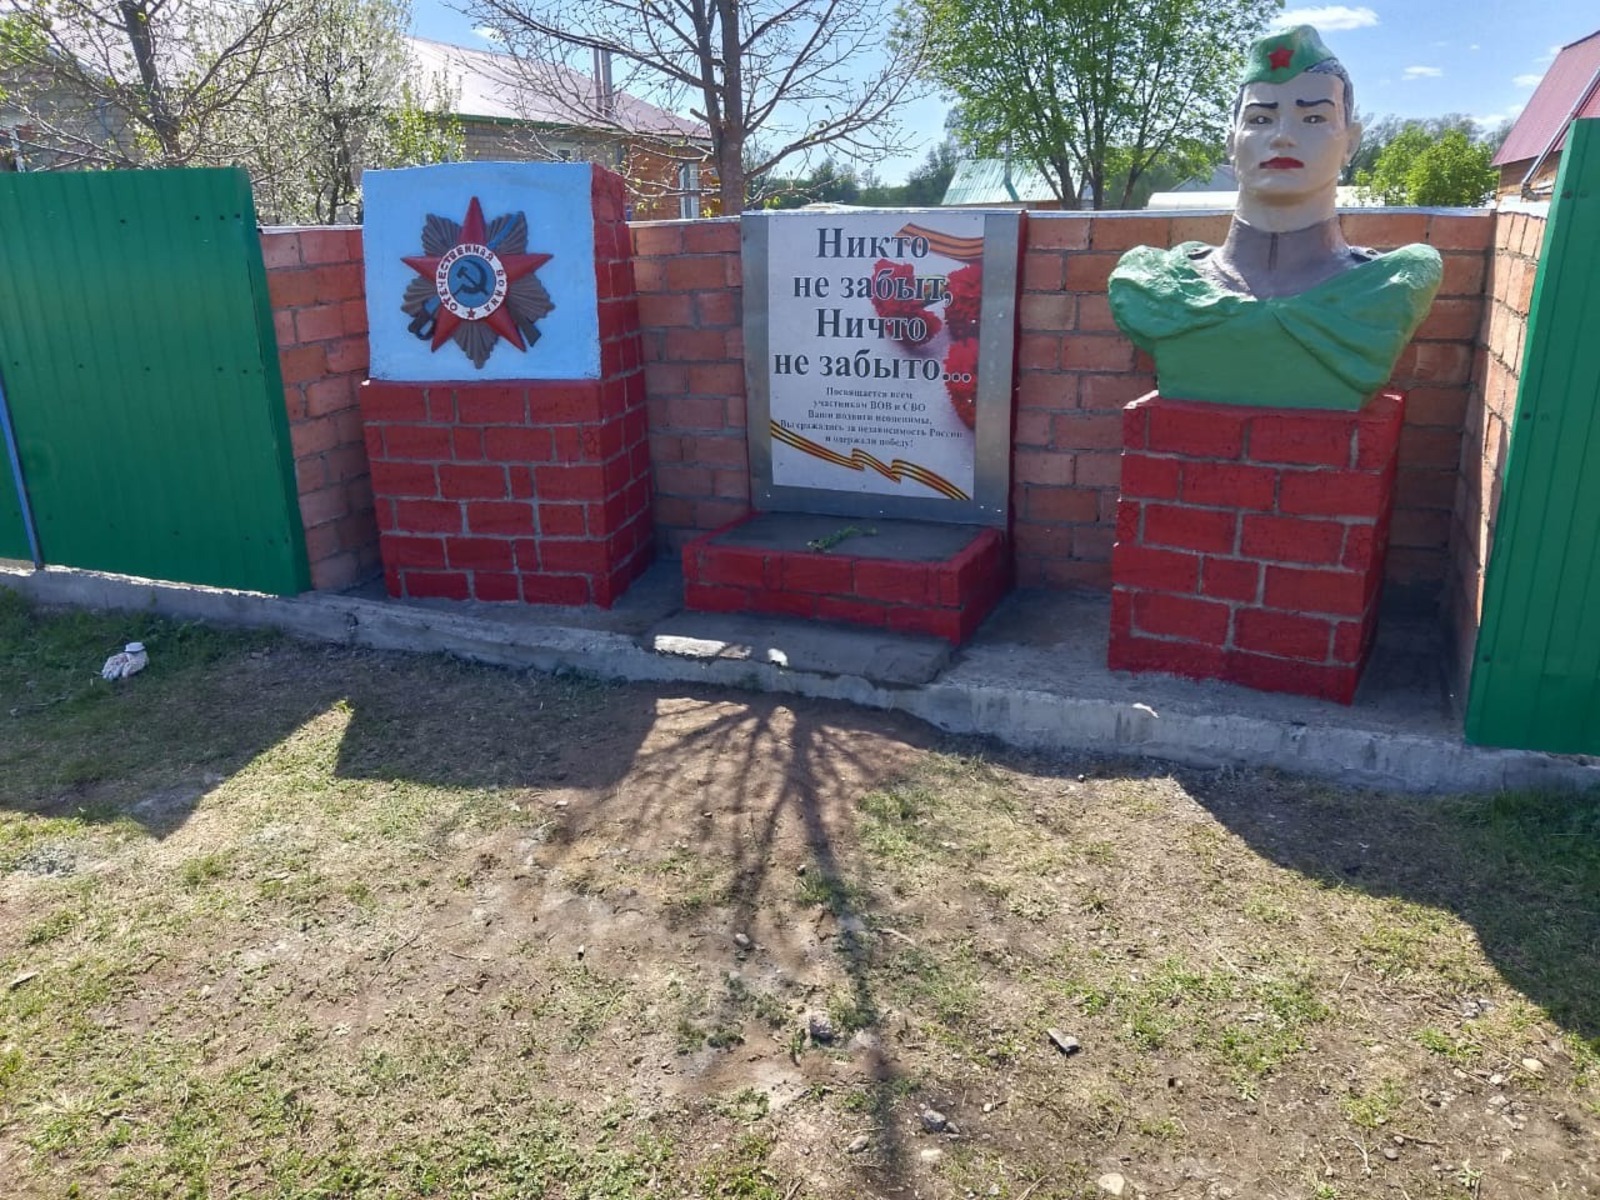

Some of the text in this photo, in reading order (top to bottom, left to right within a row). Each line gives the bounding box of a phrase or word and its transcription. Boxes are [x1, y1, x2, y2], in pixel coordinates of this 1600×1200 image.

[816, 228, 931, 259] Никто
[794, 268, 953, 305] не забыт,
[816, 308, 927, 340] Ничто
[774, 349, 972, 383] не забыто...
[813, 400, 868, 409] участникам
[870, 401, 892, 410] ВОВ
[903, 402, 926, 412] СВО
[826, 387, 913, 400] Посвящается всем
[808, 409, 834, 419] Ваши
